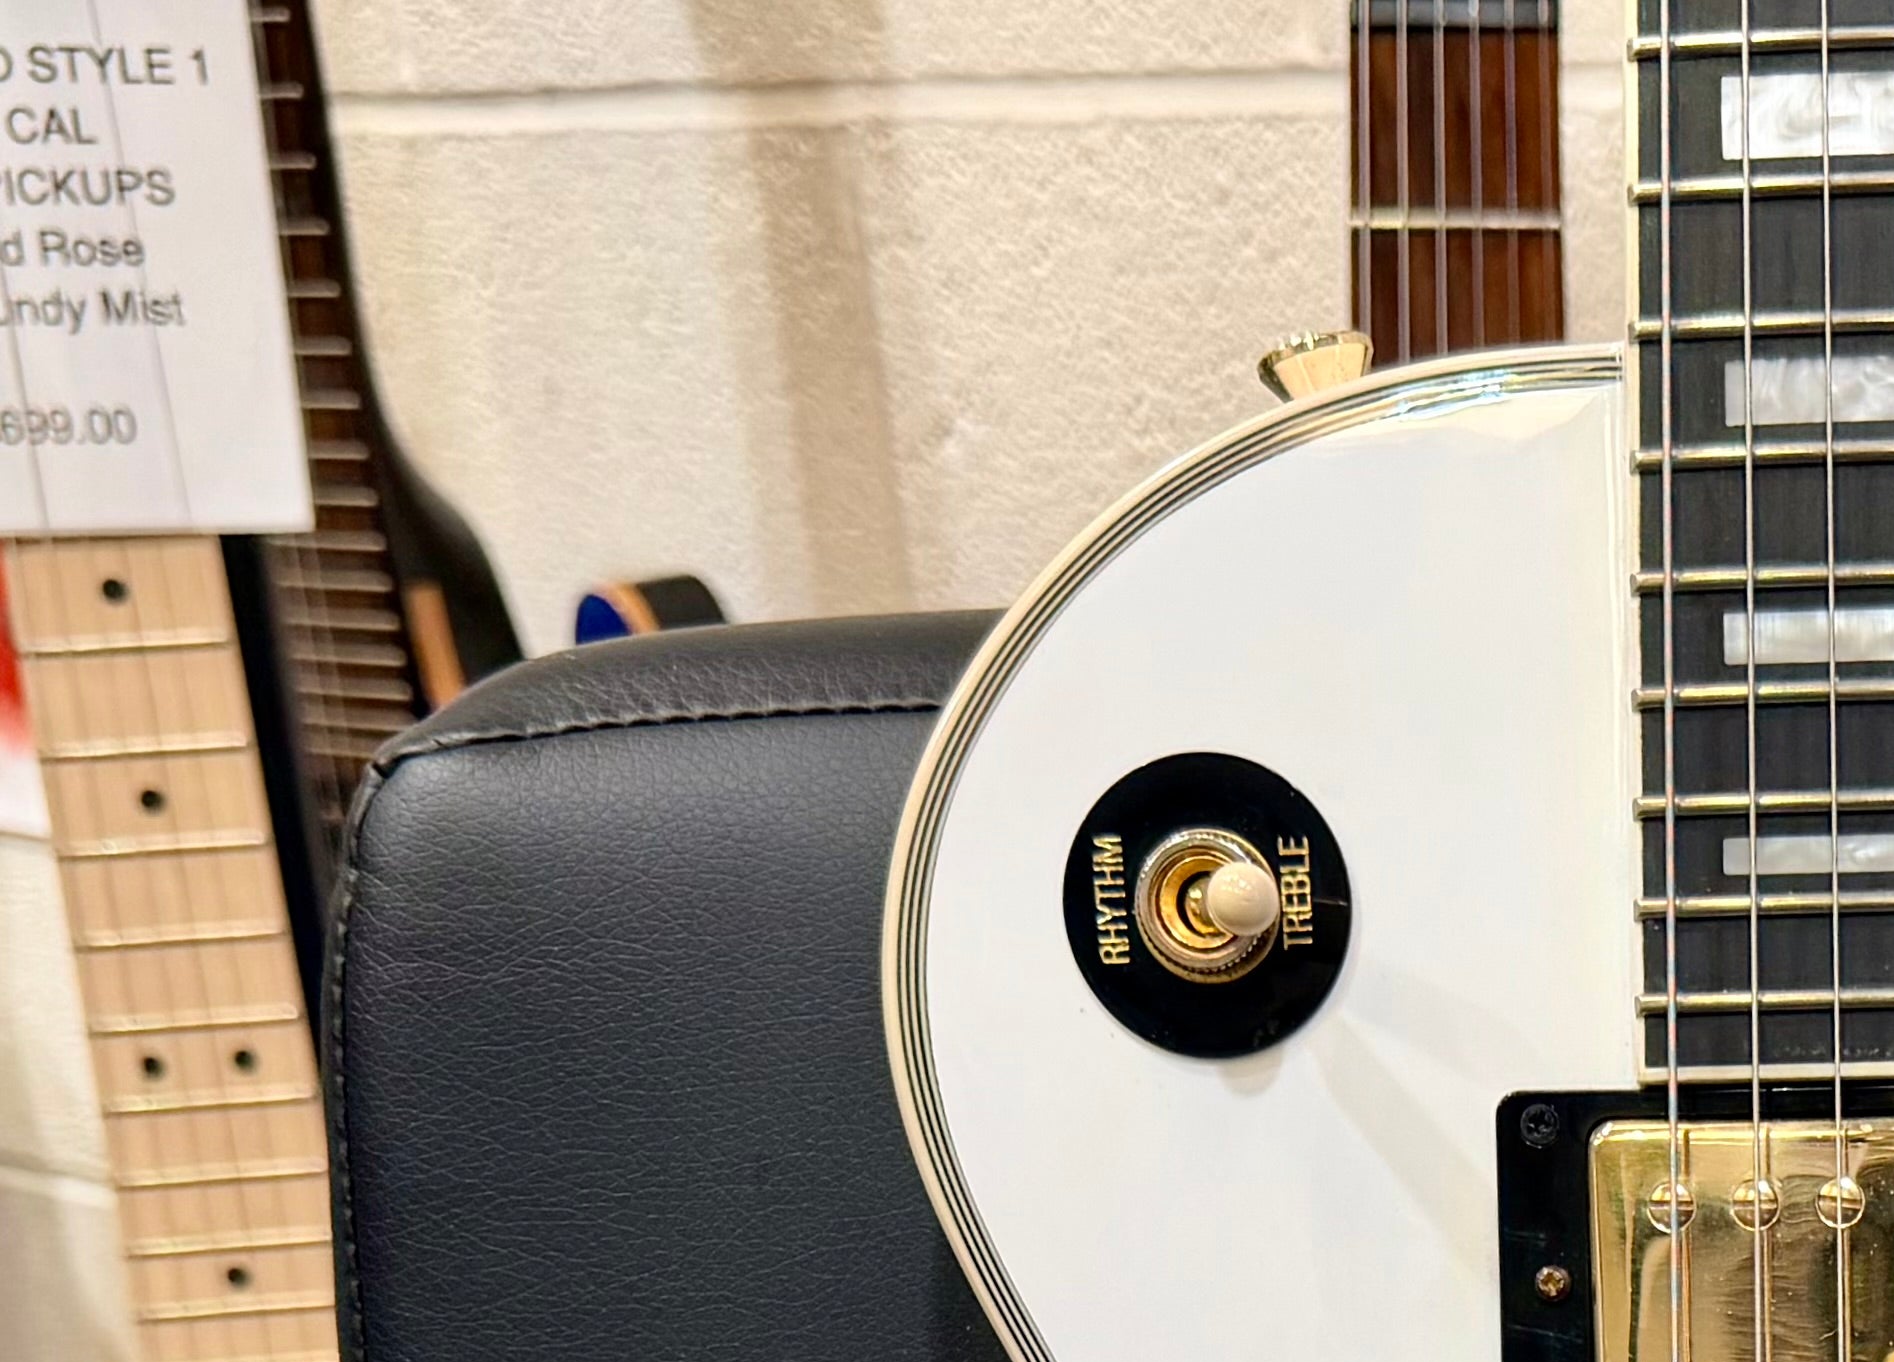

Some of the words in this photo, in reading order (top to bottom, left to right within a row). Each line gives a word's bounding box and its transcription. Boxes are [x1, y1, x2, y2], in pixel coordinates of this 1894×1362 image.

[27, 43, 175, 84] STYLE
[190, 43, 208, 85] 1
[5, 105, 98, 146] CAL
[0, 165, 176, 207] ICKUPS
[38, 226, 146, 267] Rose
[96, 286, 187, 327] Mist
[1092, 832, 1130, 965] RHYTHM
[1277, 834, 1313, 950] TREBLE
